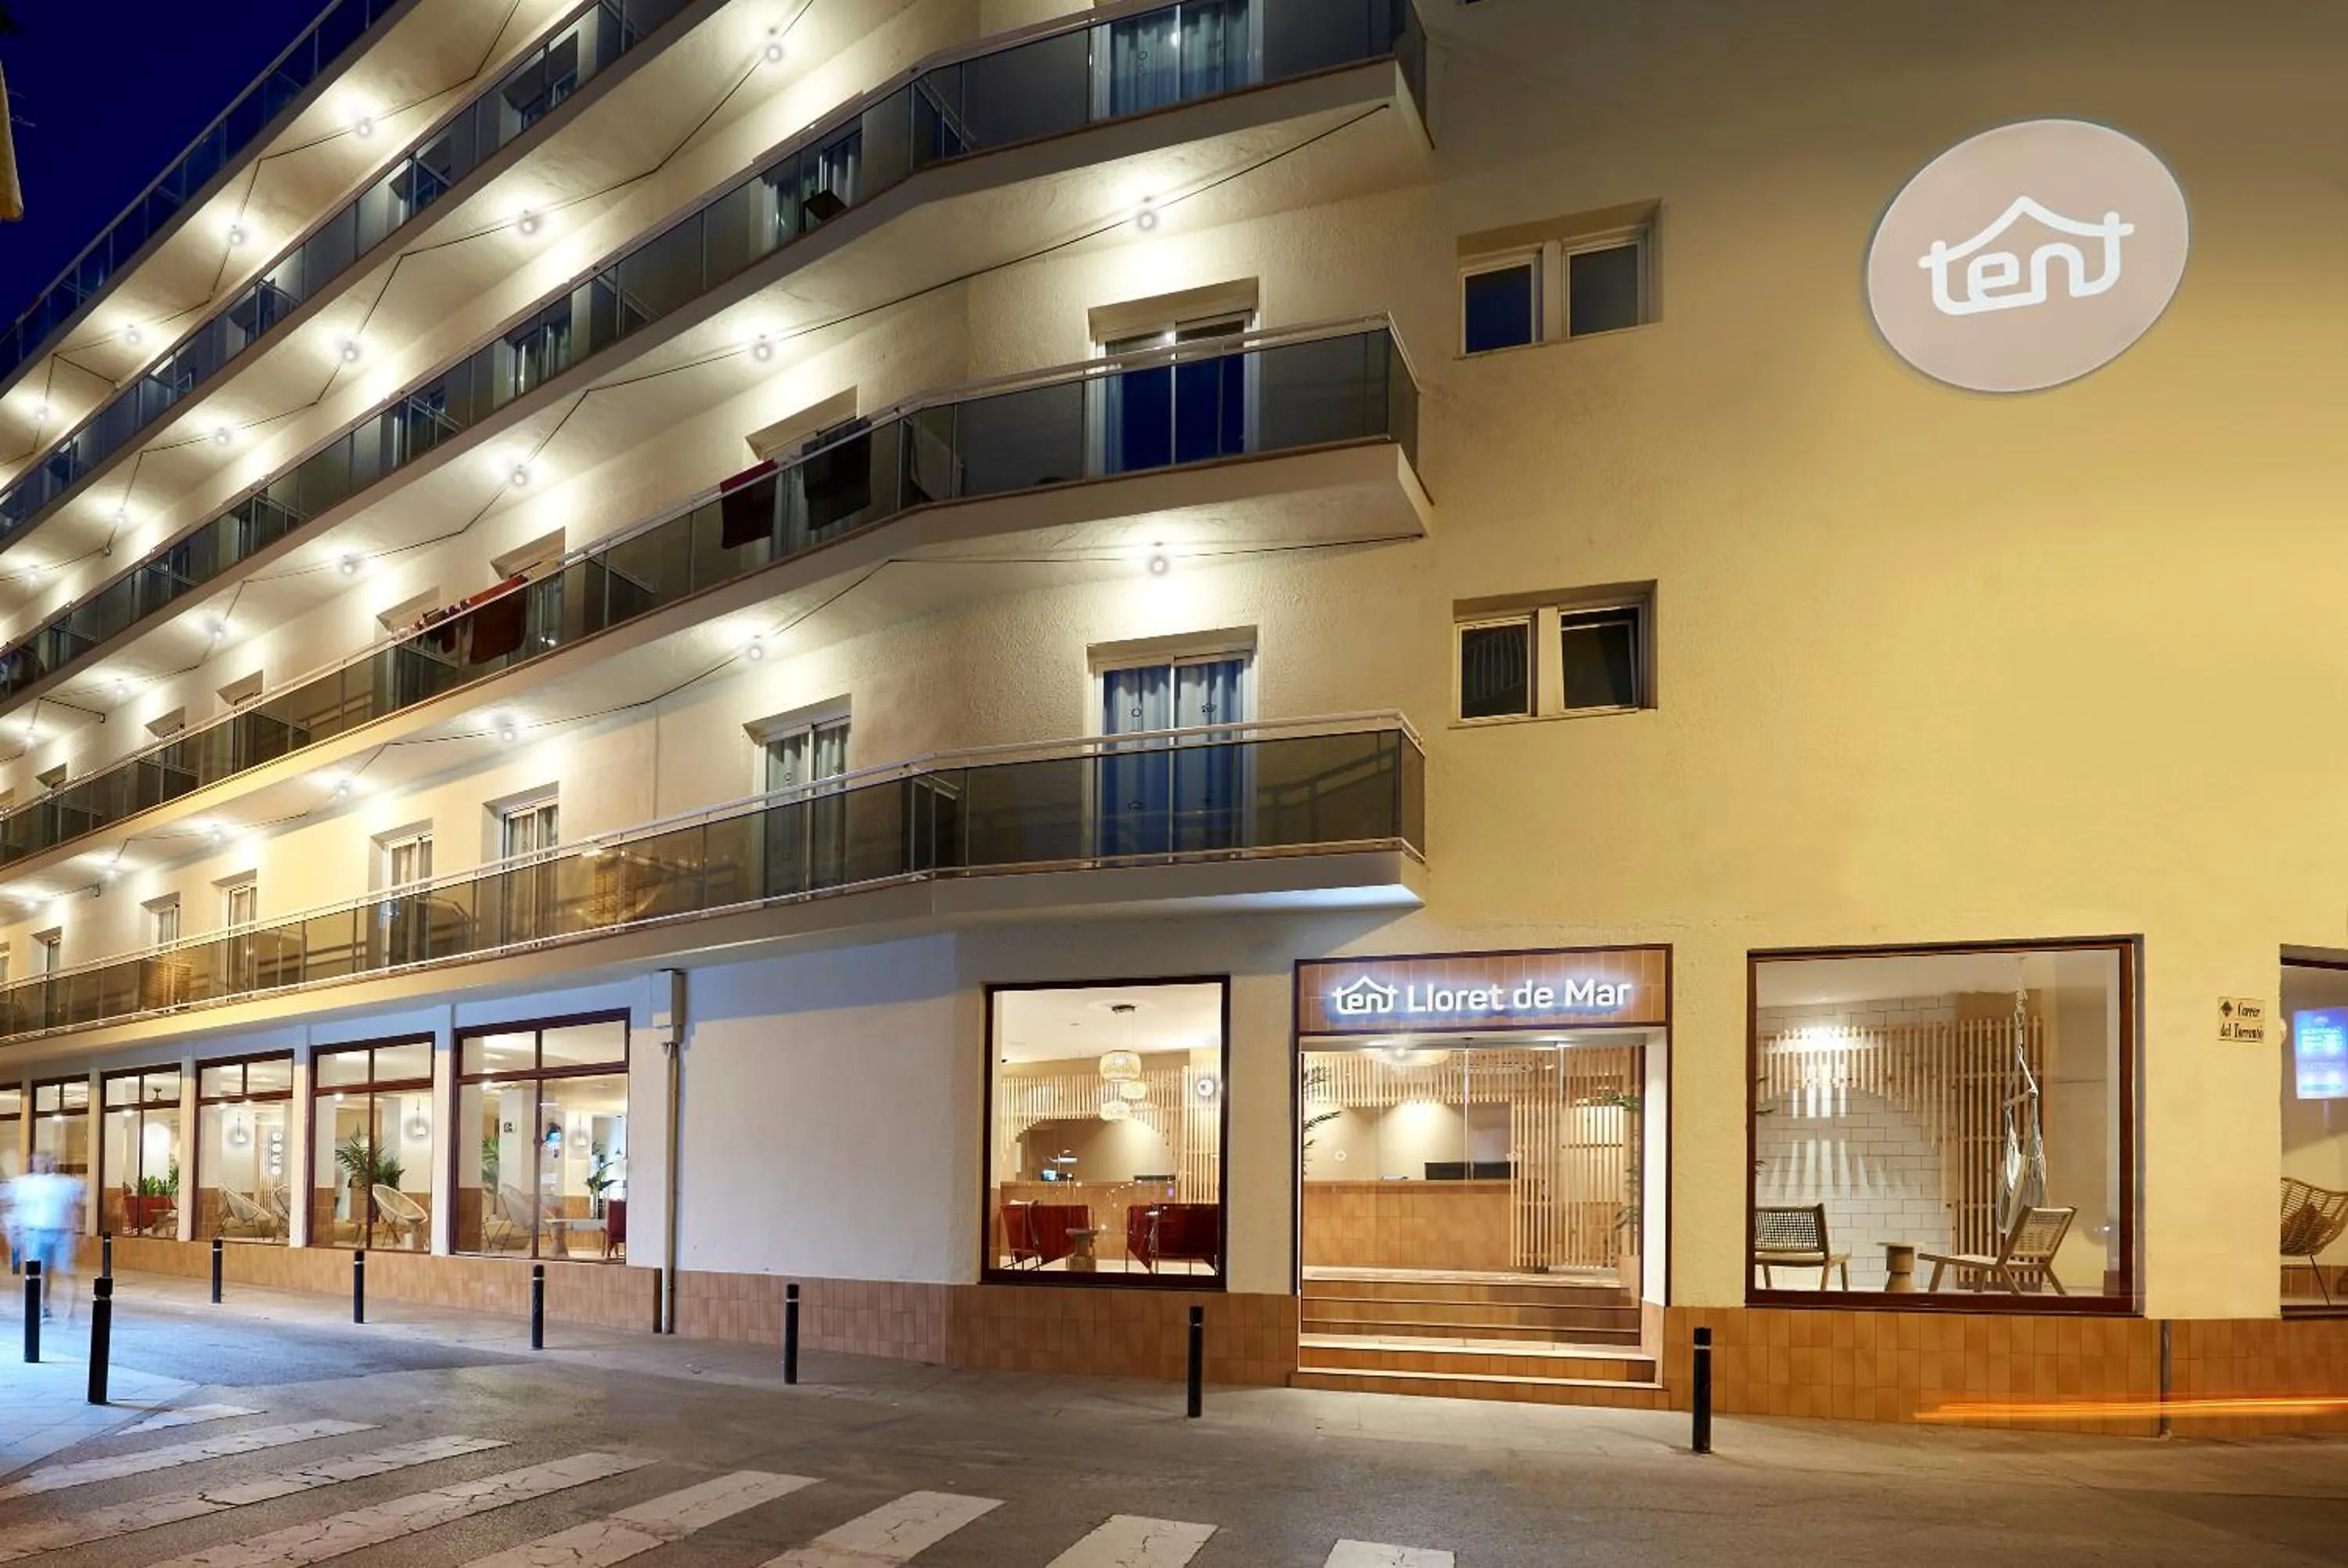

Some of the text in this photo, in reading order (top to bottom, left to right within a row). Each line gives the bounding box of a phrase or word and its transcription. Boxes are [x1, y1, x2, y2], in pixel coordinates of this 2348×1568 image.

[1918, 195, 2135, 316] tent
[1331, 975, 1633, 1015] tent Lloret de Mar
